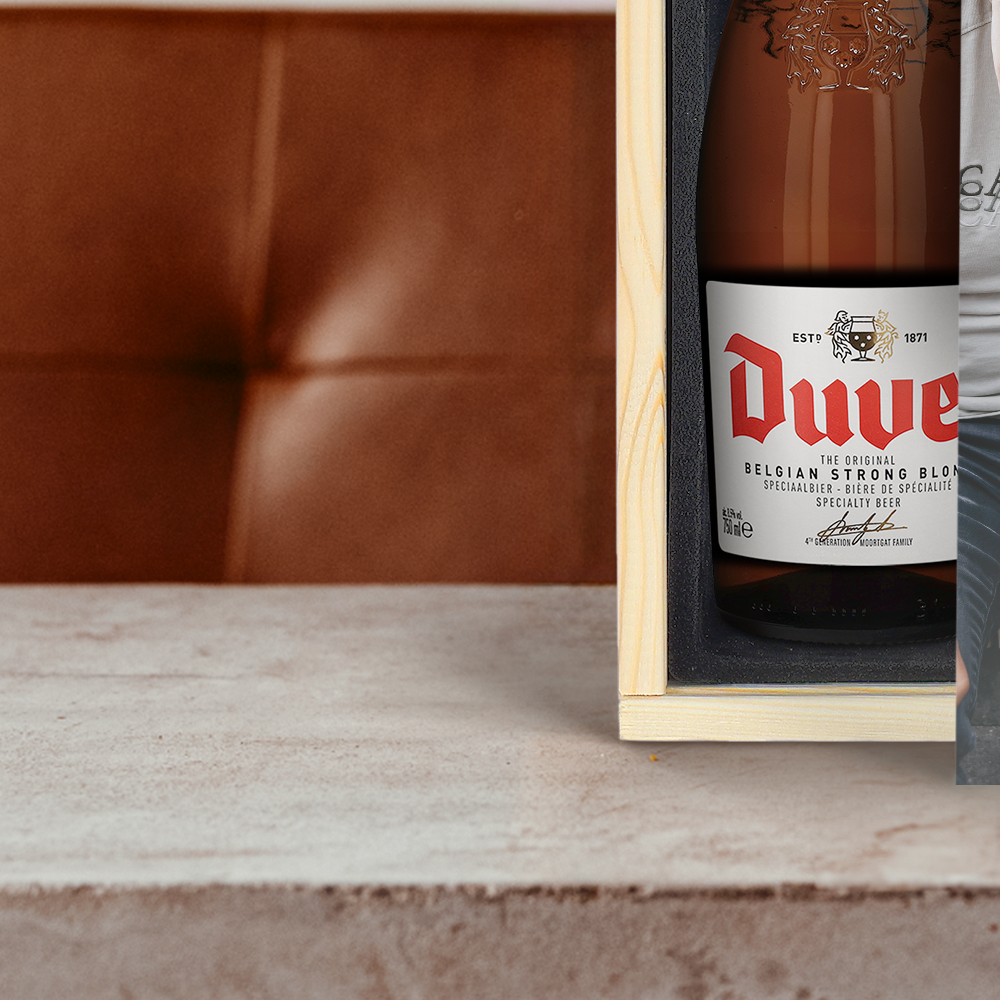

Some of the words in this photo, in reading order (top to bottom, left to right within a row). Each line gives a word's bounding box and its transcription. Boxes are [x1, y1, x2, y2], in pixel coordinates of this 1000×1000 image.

[792, 332, 822, 344] ESTD
[903, 332, 928, 344] 1871
[820, 454, 839, 466] THE
[845, 455, 896, 466] ORIGINAL
[744, 461, 818, 480] BELGIAN
[830, 467, 907, 481] STRONG
[763, 480, 834, 493] SPECIAALBIER
[845, 481, 876, 495] BIÈRE
[881, 483, 893, 495] DE
[898, 479, 952, 493] SPÉCIALITÉ
[815, 496, 871, 509] SPECIALTY
[875, 496, 901, 509] BEER
[814, 537, 851, 546] GENERATION
[859, 538, 891, 547] MOORTGAT
[892, 537, 914, 547] FAMILY
